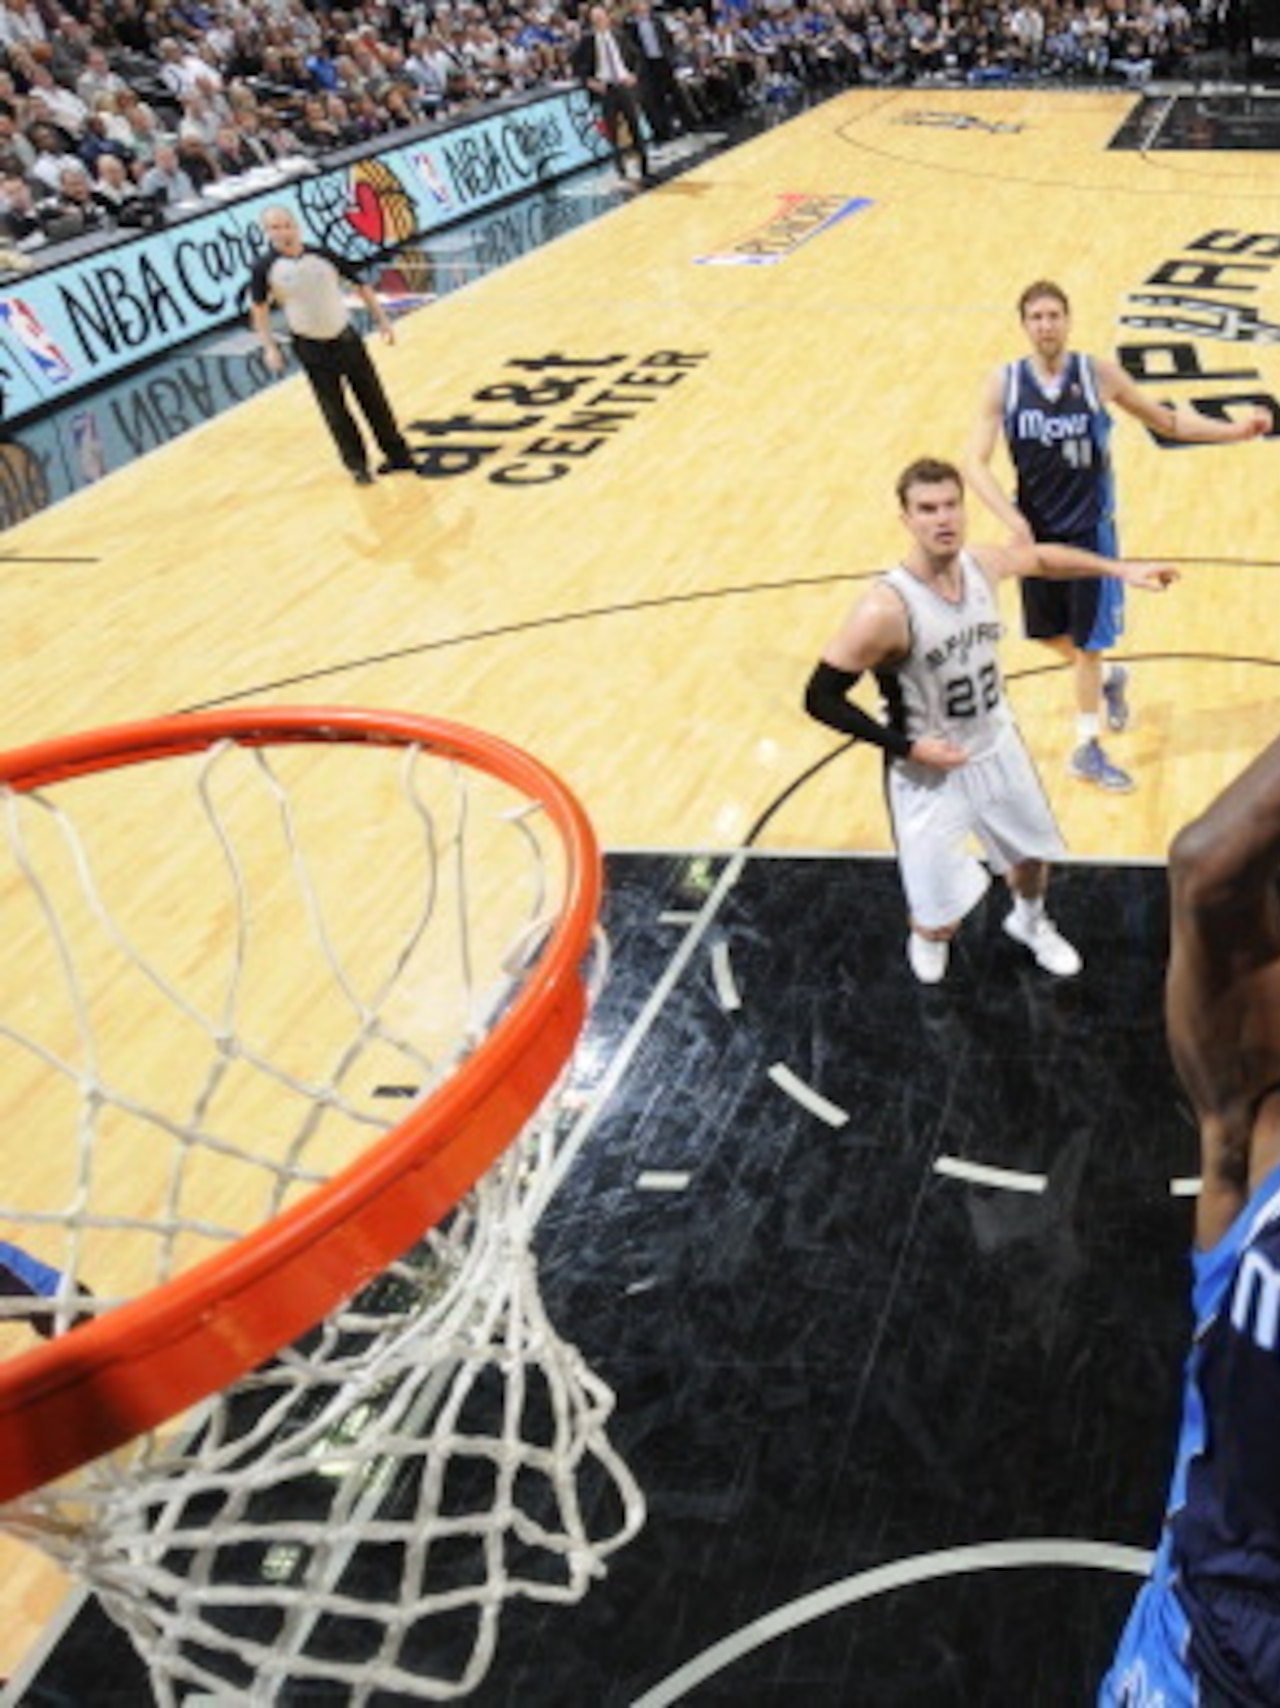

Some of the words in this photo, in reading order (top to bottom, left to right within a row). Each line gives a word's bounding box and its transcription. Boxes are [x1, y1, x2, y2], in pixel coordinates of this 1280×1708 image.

[57, 253, 188, 367] NBA
[174, 220, 270, 317] Care
[403, 352, 629, 478] at&t
[487, 349, 710, 486] CENTER
[1061, 438, 1093, 468] 41
[946, 661, 999, 718] 22
